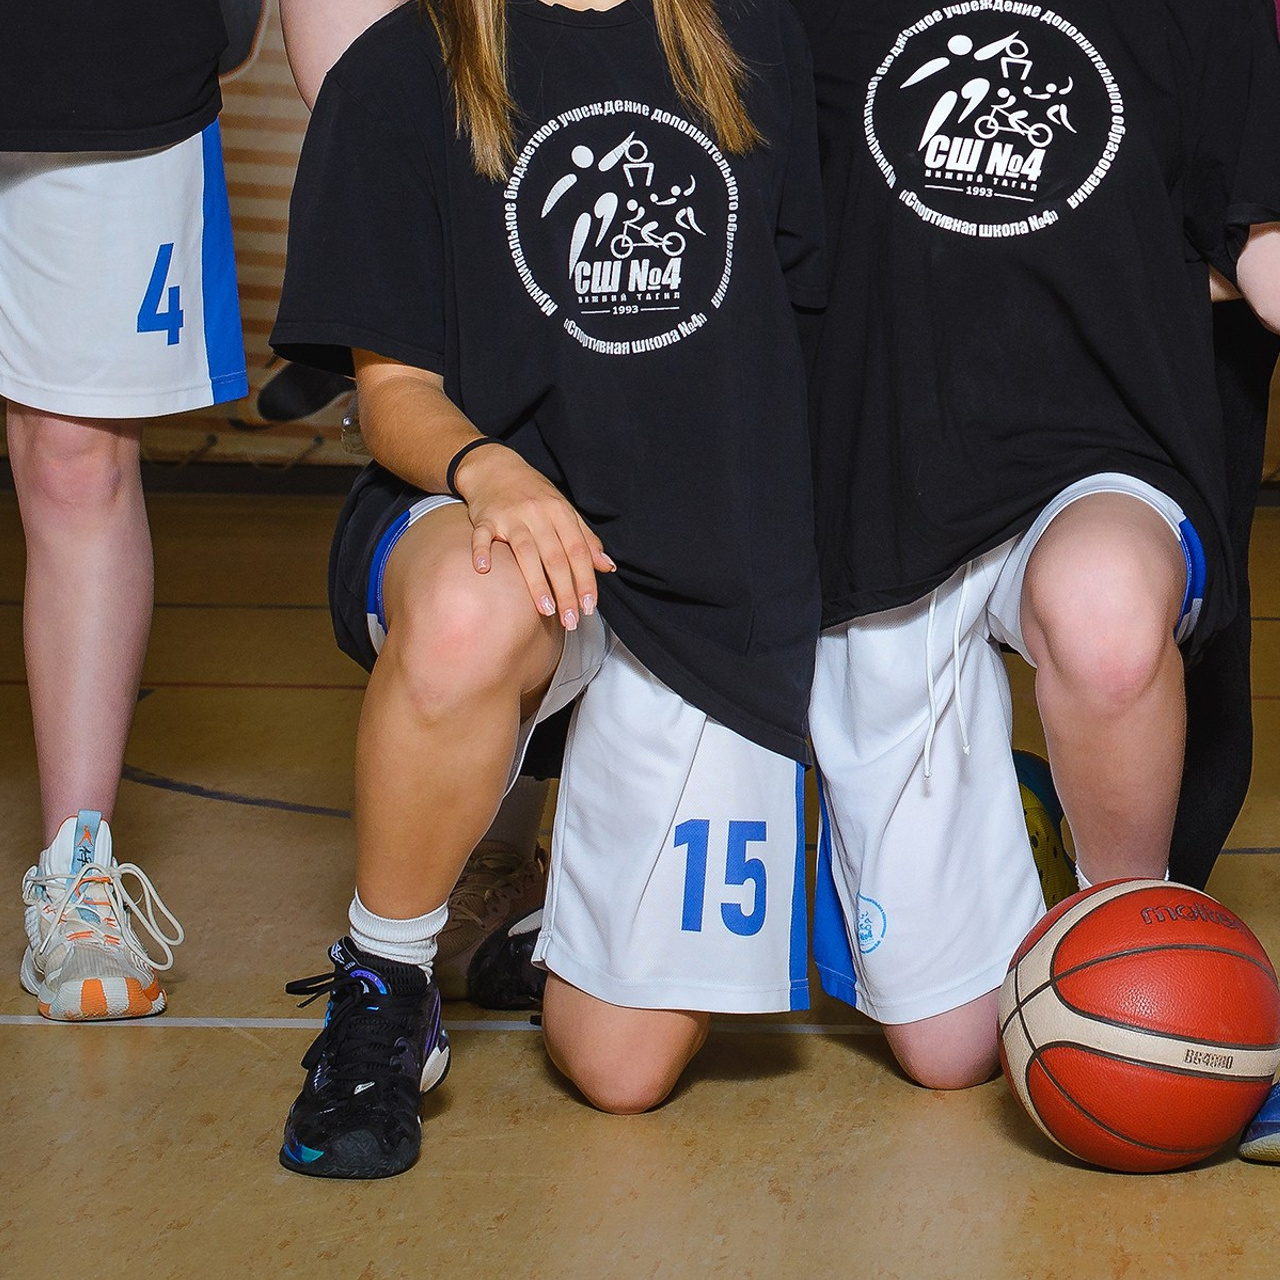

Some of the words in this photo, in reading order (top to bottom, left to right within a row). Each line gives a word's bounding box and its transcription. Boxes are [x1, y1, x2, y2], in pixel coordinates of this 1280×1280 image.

[876, 9, 943, 81] бюджетное
[1040, 10, 1124, 113] дополнительного
[557, 99, 650, 127] учреждение
[504, 119, 560, 199] бюджетное
[651, 107, 738, 211] дополнительного
[924, 135, 985, 173] СШ
[1066, 117, 1126, 209] образования
[966, 186, 993, 197] 1993
[505, 202, 558, 317] Муниципальное
[711, 213, 738, 308] образования
[979, 221, 1029, 238] школа
[137, 243, 184, 345] 4
[574, 260, 622, 294] СШ
[612, 305, 639, 315] 1993
[631, 330, 680, 354] школа
[674, 819, 767, 936] 15
[1140, 901, 1244, 931] molte
